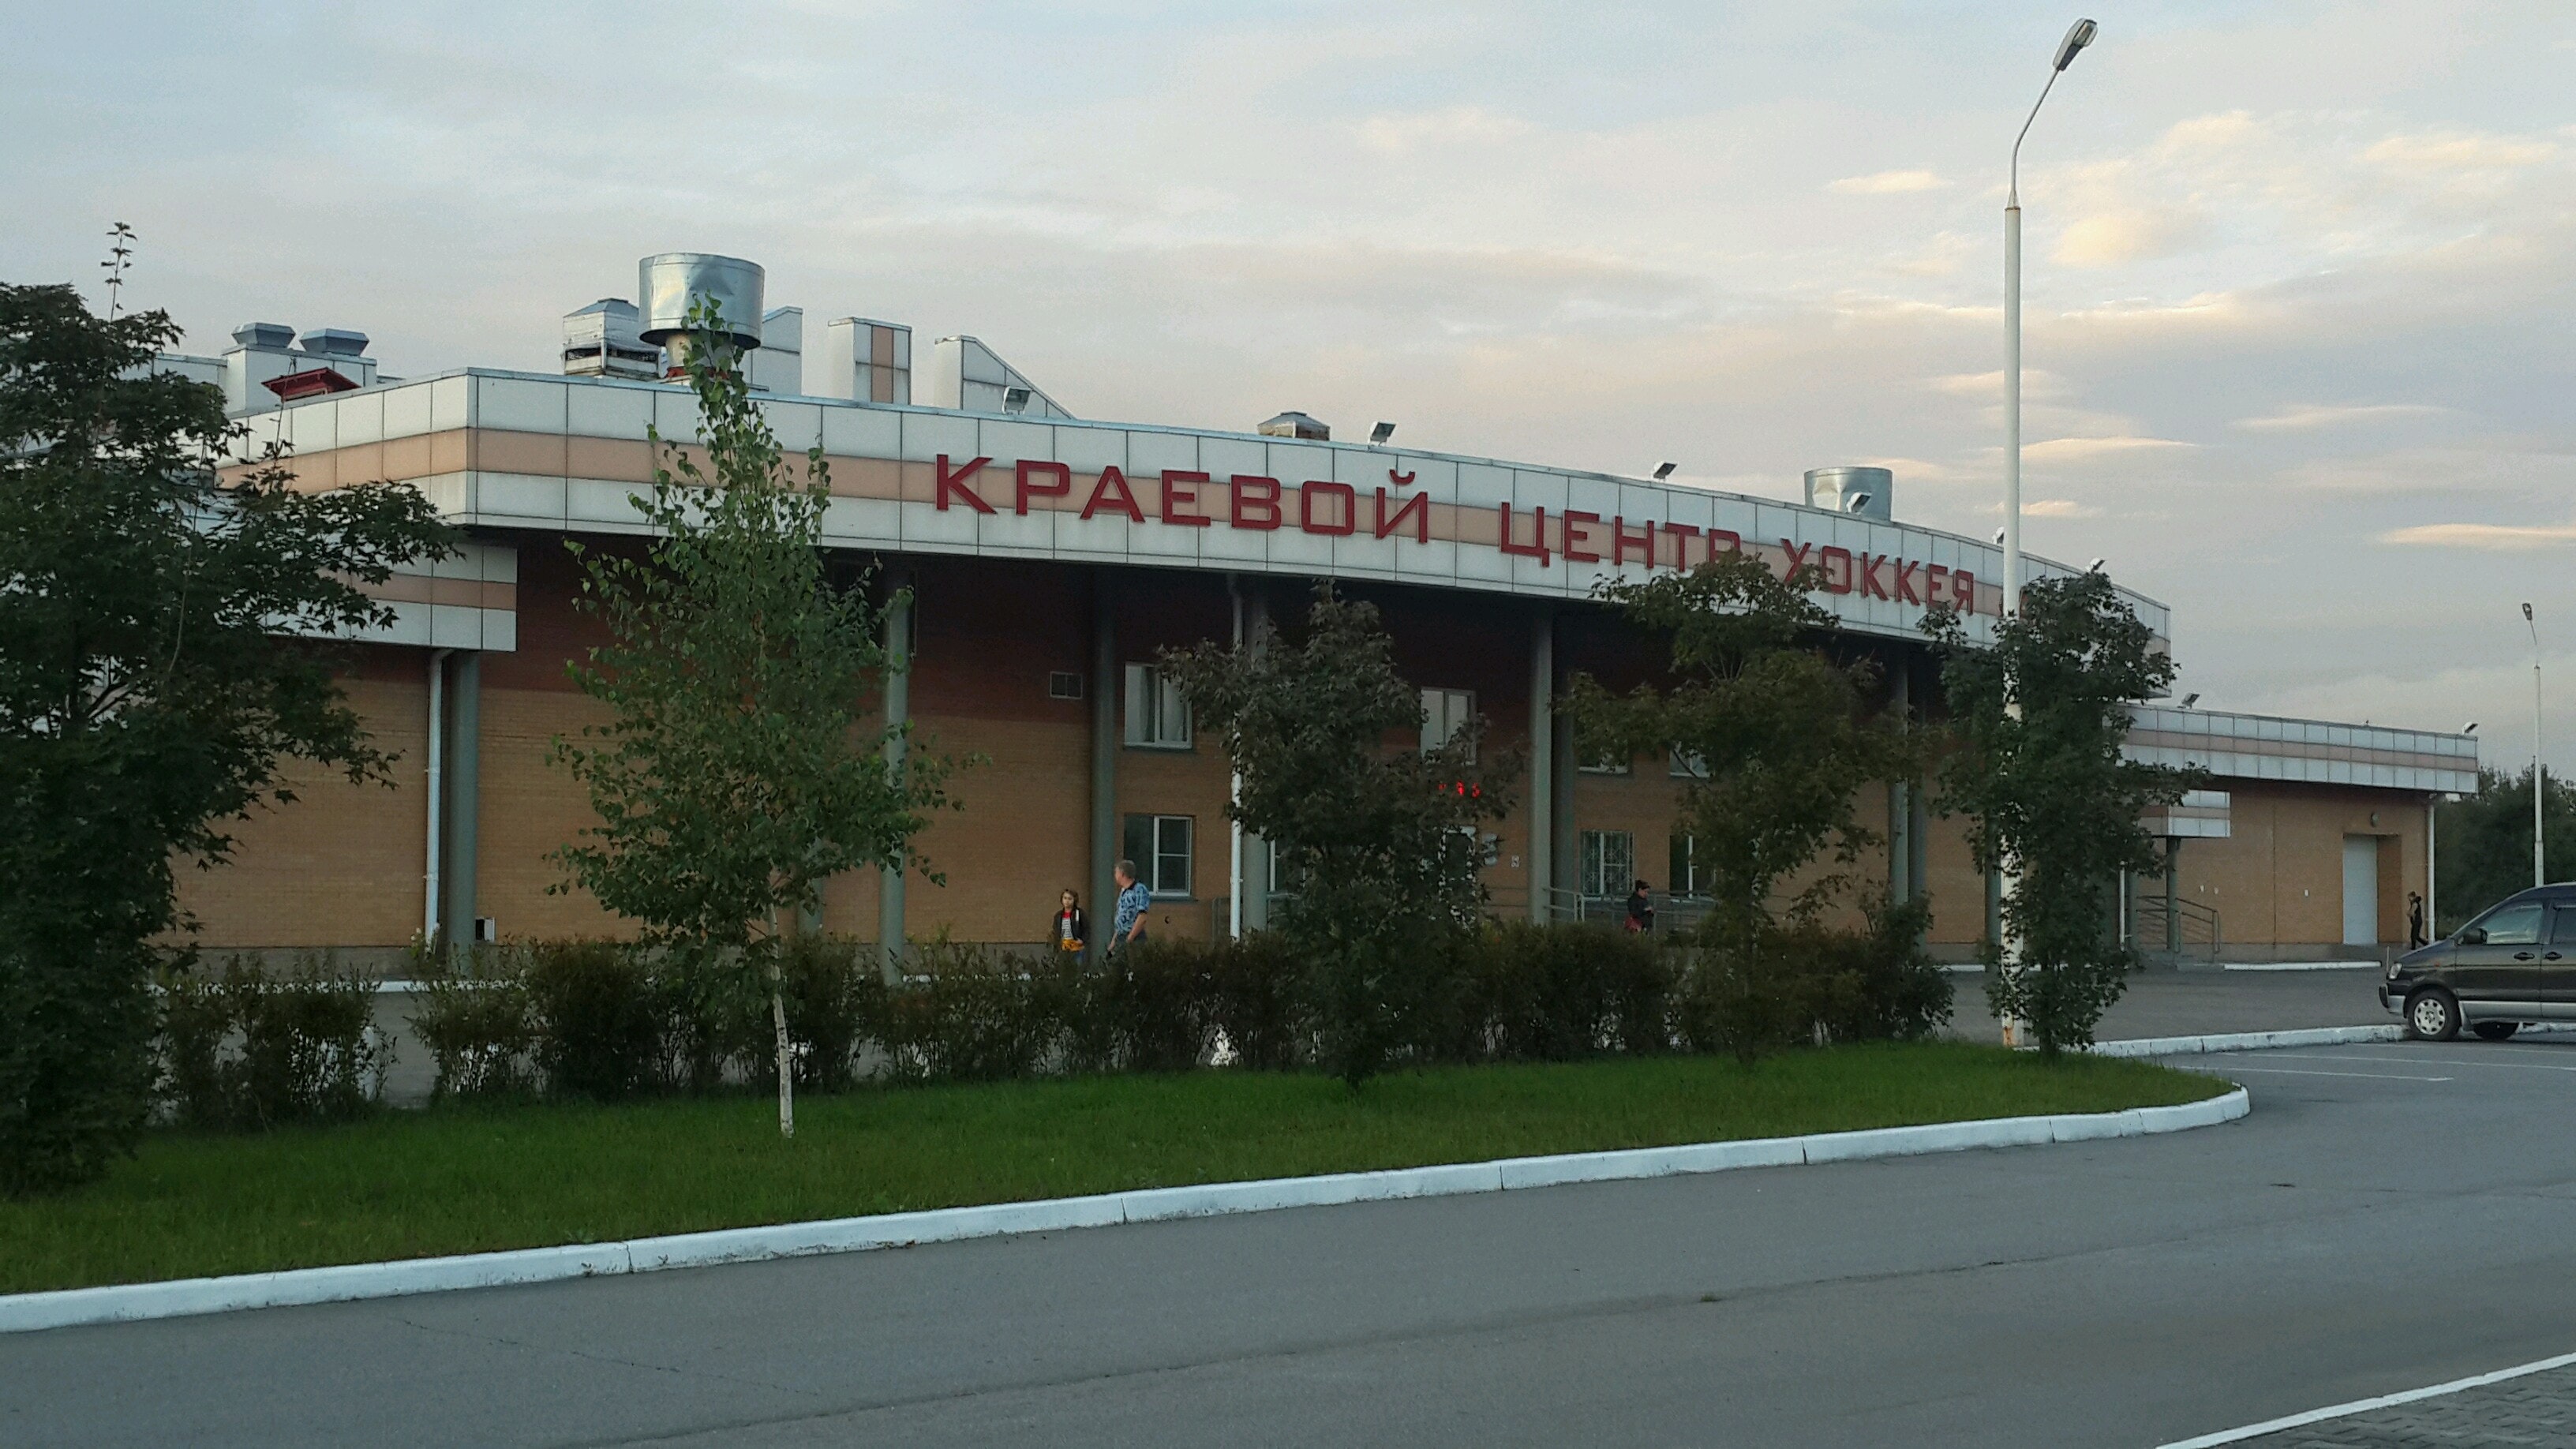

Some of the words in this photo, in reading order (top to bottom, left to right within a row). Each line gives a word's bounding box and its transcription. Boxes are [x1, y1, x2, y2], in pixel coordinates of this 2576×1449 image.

[936, 454, 1429, 545] КРАЕВОЙ
[1500, 502, 1741, 573] ЦЕНТР
[1780, 537, 1974, 616] ХОККЕЯ
